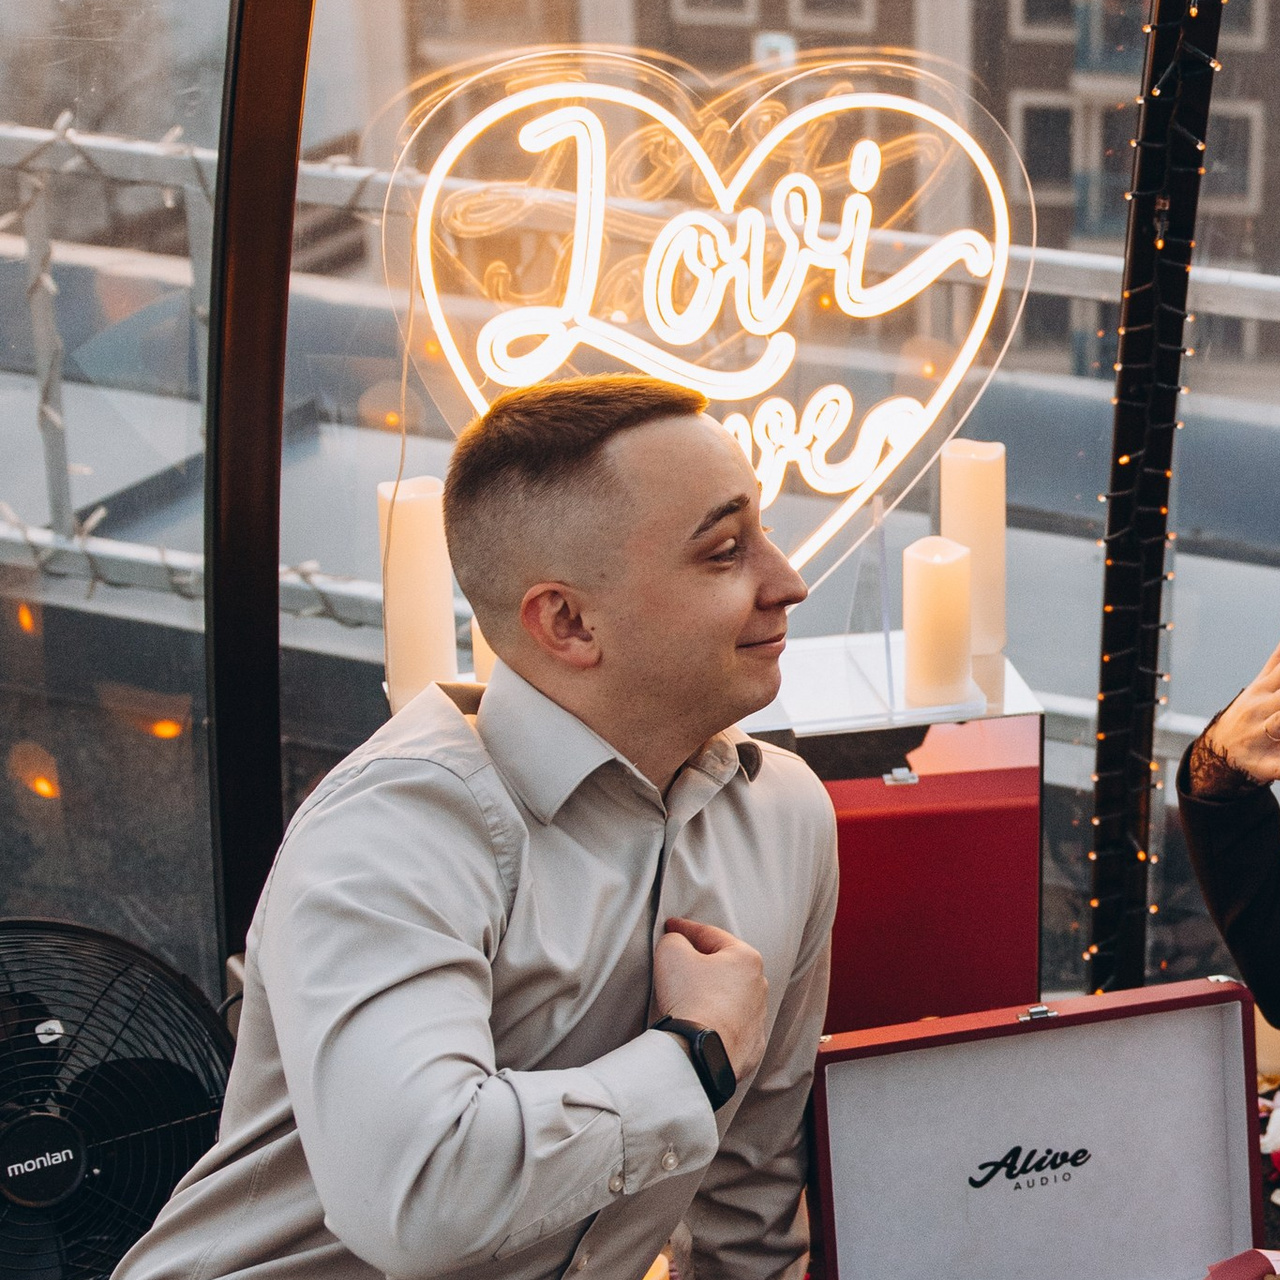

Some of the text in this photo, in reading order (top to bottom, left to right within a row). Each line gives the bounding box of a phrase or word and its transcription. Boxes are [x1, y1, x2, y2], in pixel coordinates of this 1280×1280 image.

[476, 106, 994, 401] Lovi
[7, 1149, 74, 1178] monlan
[968, 1145, 1092, 1189] Alive
[1013, 1172, 1072, 1191] AUDIO
